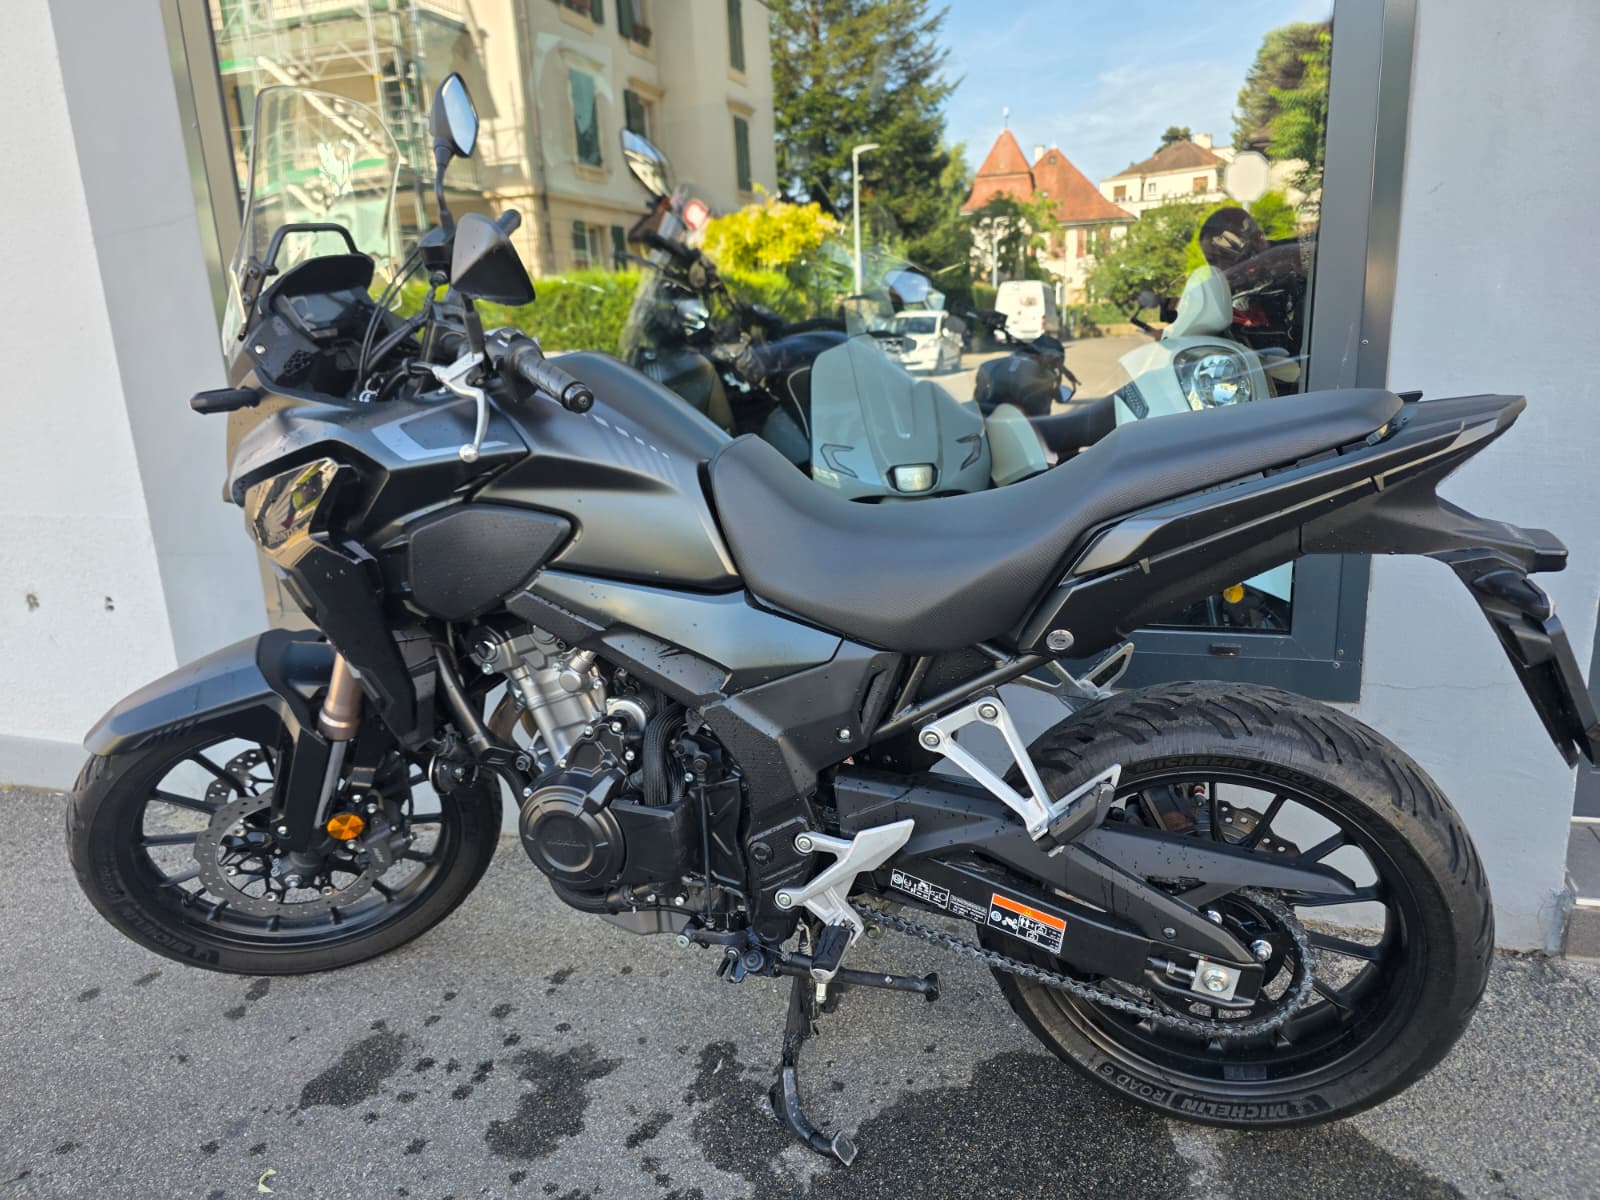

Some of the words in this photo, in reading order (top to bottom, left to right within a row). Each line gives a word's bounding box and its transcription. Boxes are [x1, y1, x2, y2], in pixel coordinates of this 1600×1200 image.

[1136, 756, 1249, 773] MICHELIN
[1102, 1065, 1114, 1077] 6
[1115, 1068, 1168, 1100] ROAD
[1181, 1098, 1289, 1120] MICHELIN
